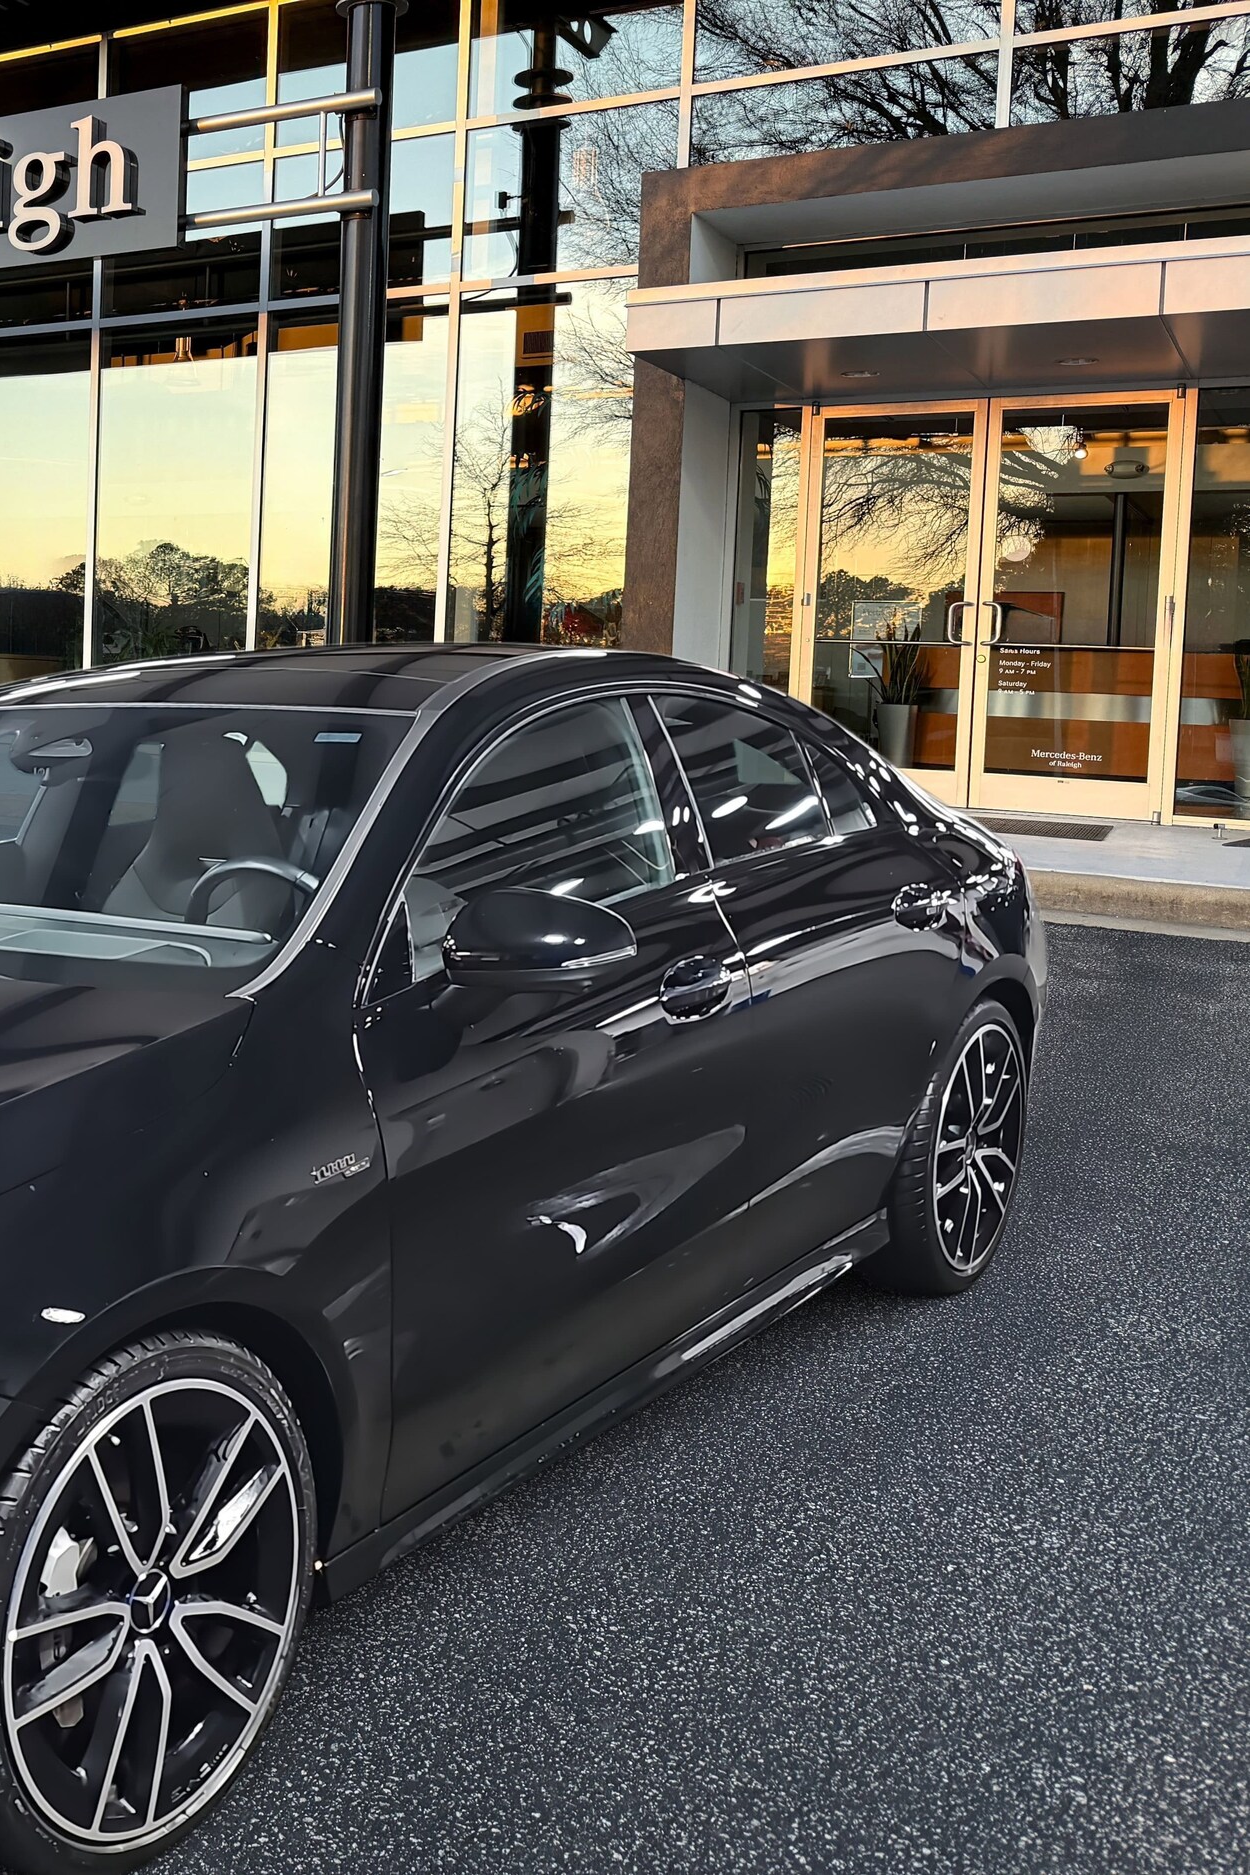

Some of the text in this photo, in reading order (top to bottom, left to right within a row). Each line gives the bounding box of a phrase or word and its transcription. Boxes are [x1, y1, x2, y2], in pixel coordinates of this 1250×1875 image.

[998, 660, 1025, 668] Monday
[1030, 661, 1051, 669] Friday
[998, 680, 1028, 688] Saturday
[1031, 749, 1103, 762] Mercedes-Benz
[1057, 760, 1082, 769] Raleigh
